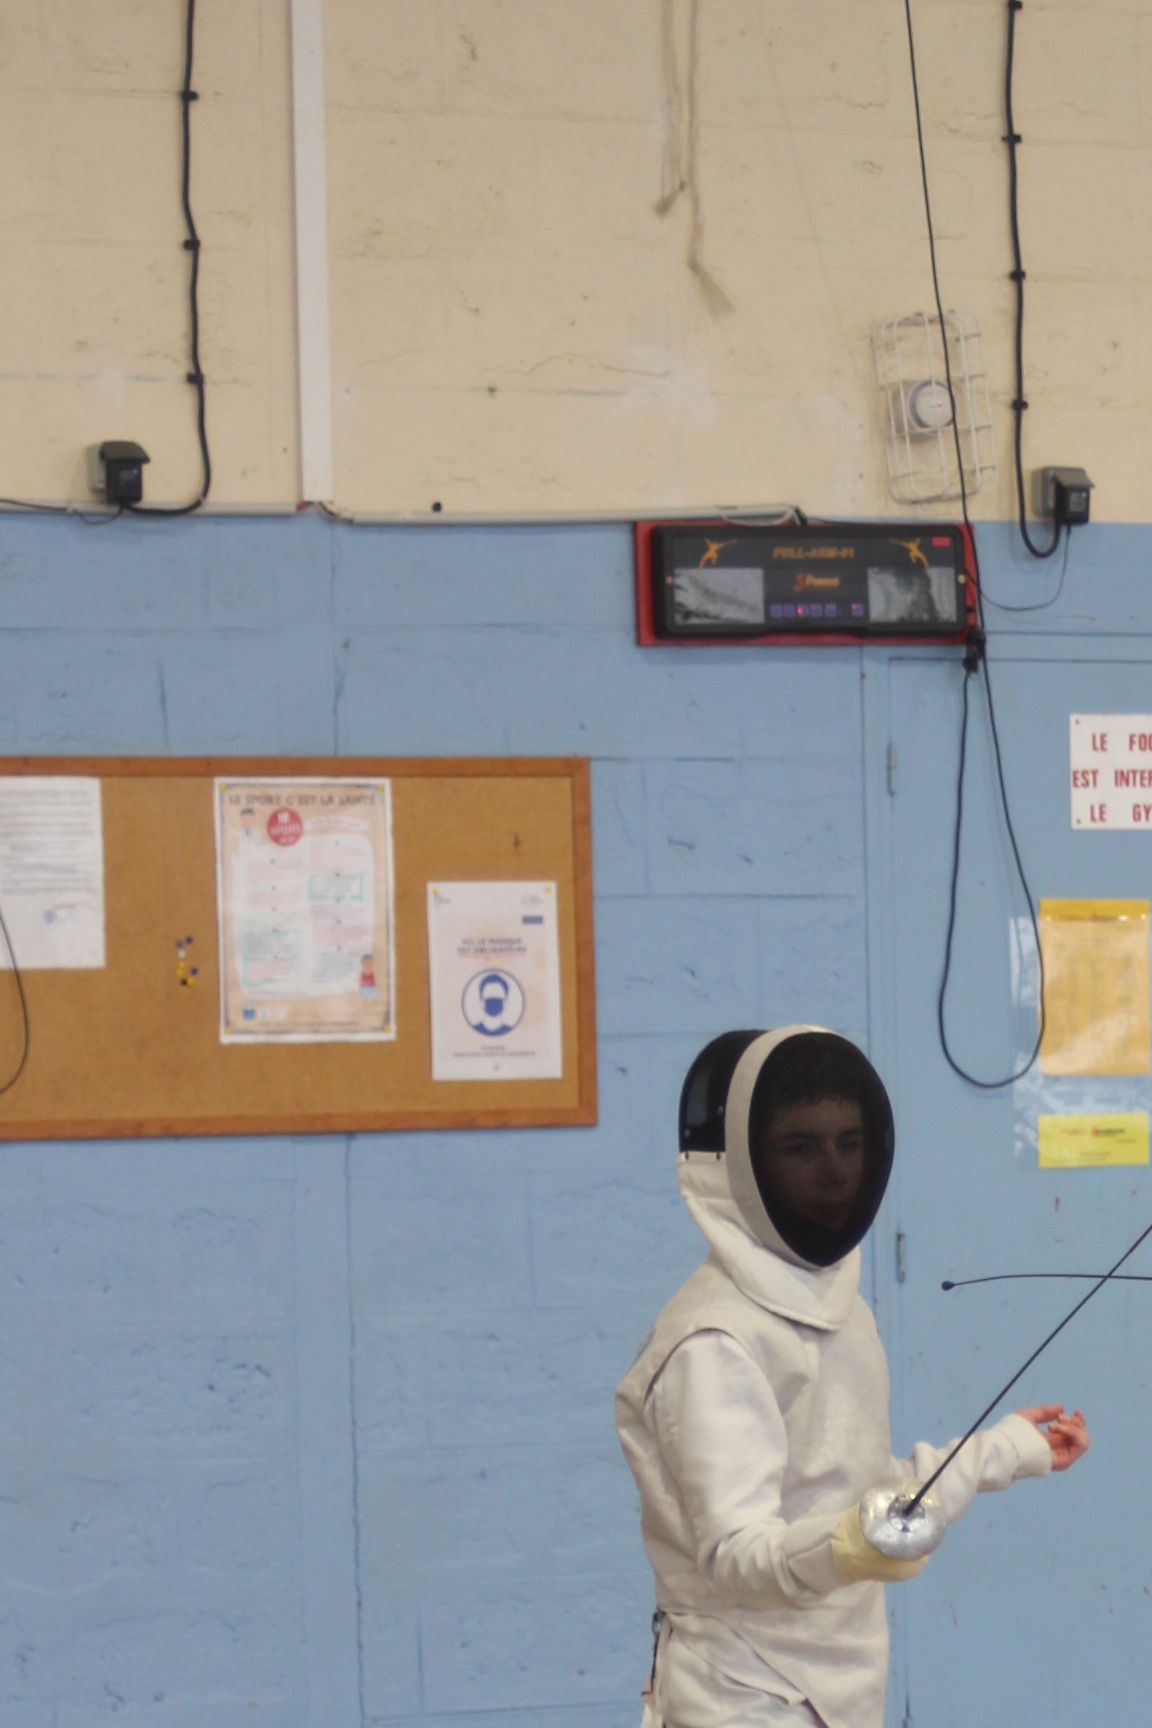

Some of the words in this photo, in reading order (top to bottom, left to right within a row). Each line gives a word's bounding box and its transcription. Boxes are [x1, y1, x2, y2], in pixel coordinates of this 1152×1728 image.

[1092, 733, 1109, 752] LE
[1072, 768, 1099, 789] EST
[1090, 804, 1108, 823] LE
